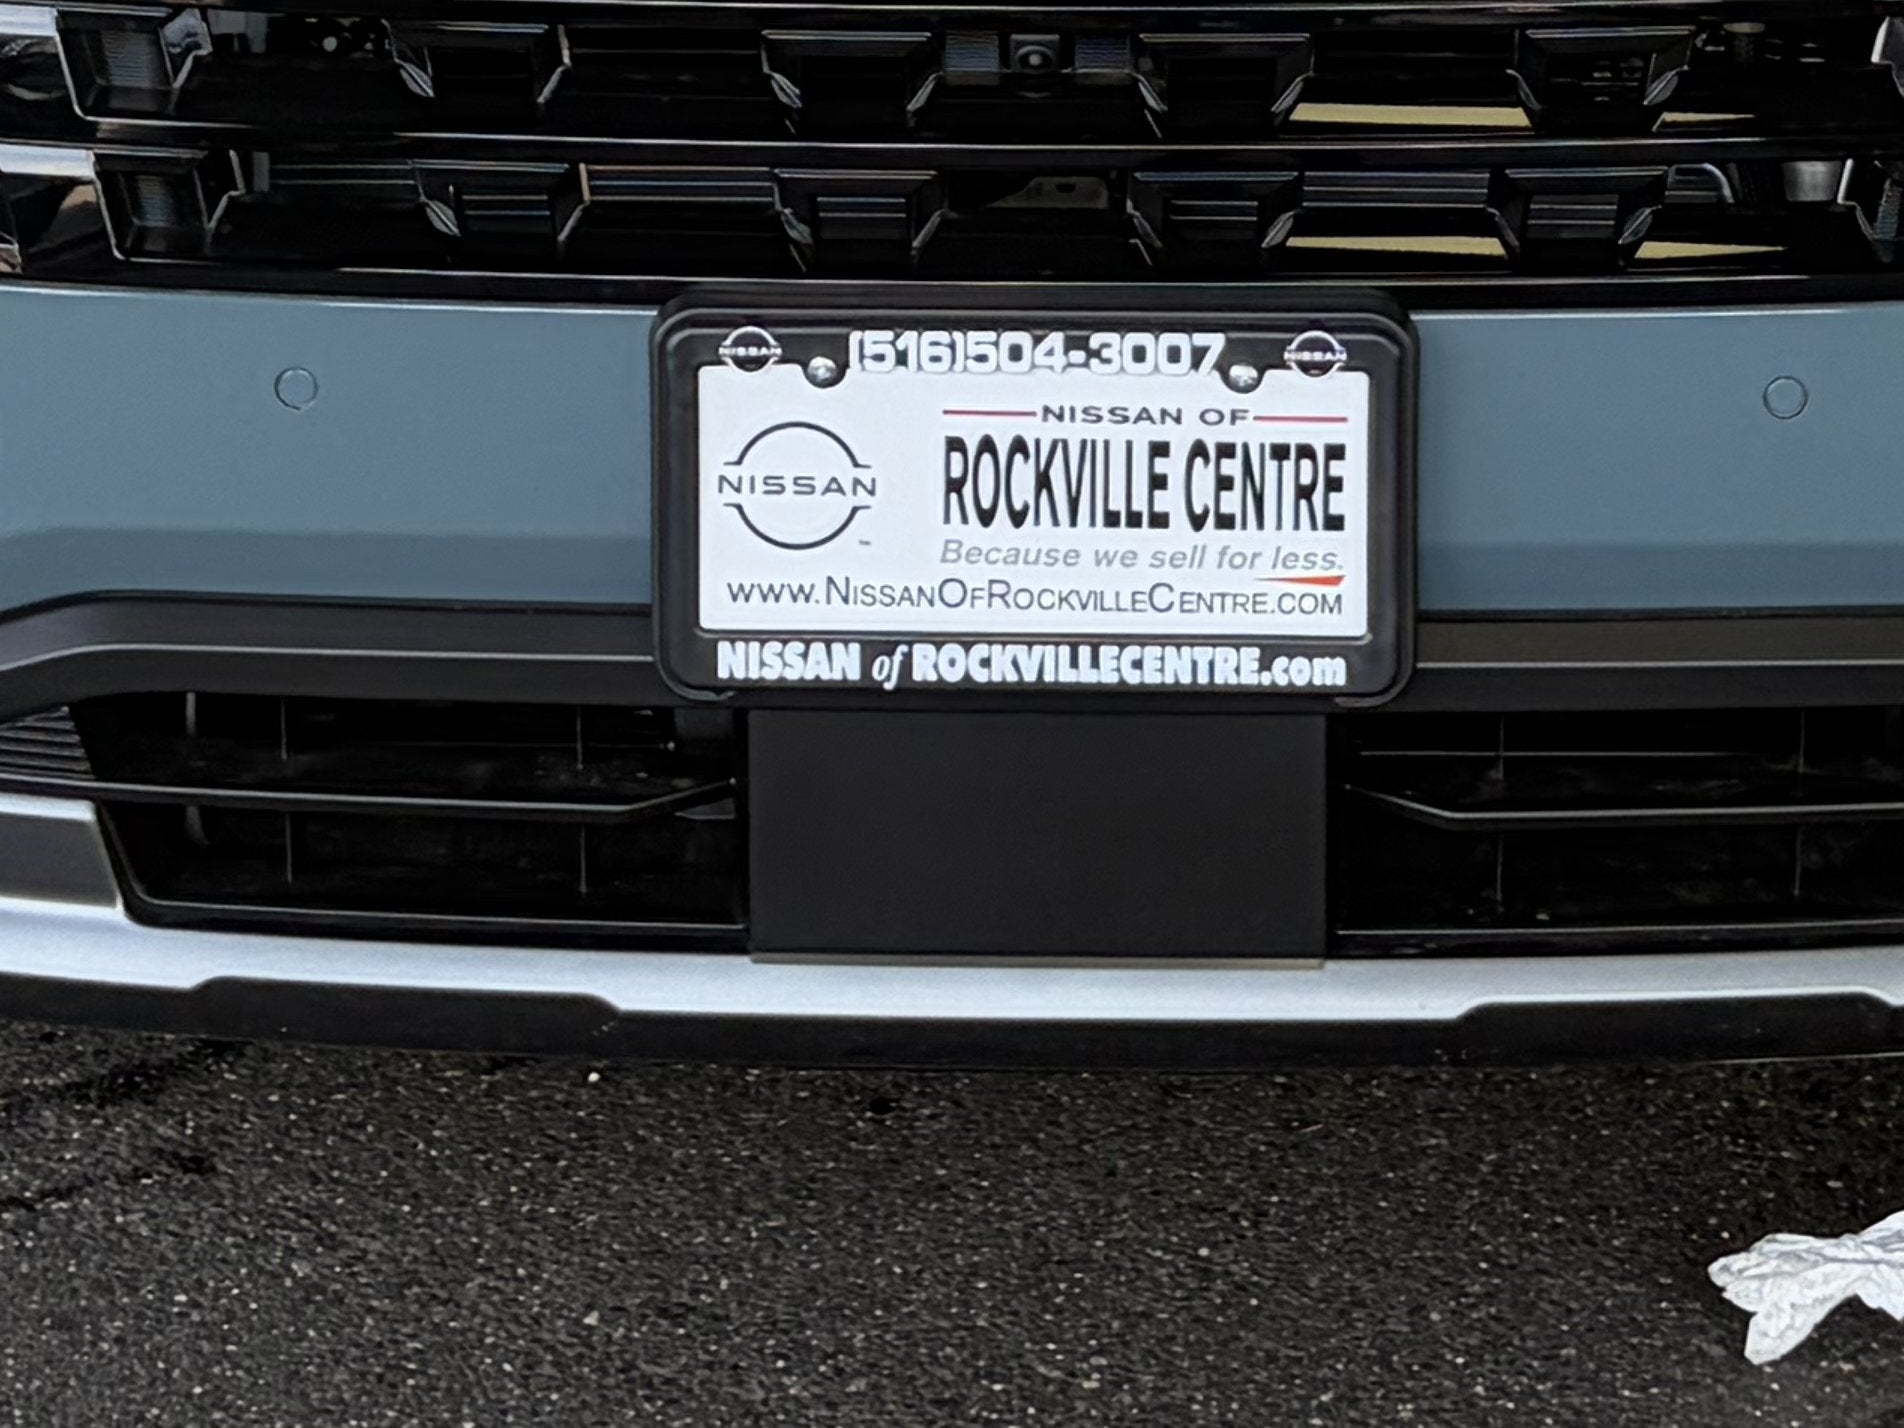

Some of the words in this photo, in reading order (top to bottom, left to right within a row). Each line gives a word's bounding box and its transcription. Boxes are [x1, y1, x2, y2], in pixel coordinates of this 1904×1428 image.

[849, 330, 1227, 376] (516)504-3007
[1041, 405, 1183, 425] NISSAN
[1199, 408, 1251, 426] OF
[717, 474, 877, 497] NISSAN
[943, 433, 1171, 530] ROCKVILLE
[1184, 437, 1347, 533] CENTRE
[940, 538, 1081, 567] Because
[1095, 548, 1139, 568] we
[1149, 543, 1208, 570] sell
[1217, 544, 1263, 571] for
[1271, 545, 1345, 572] less.
[717, 640, 862, 682] NISSAN
[871, 644, 909, 691] of
[911, 642, 1347, 687] ROCKVILLECENTRE.com
